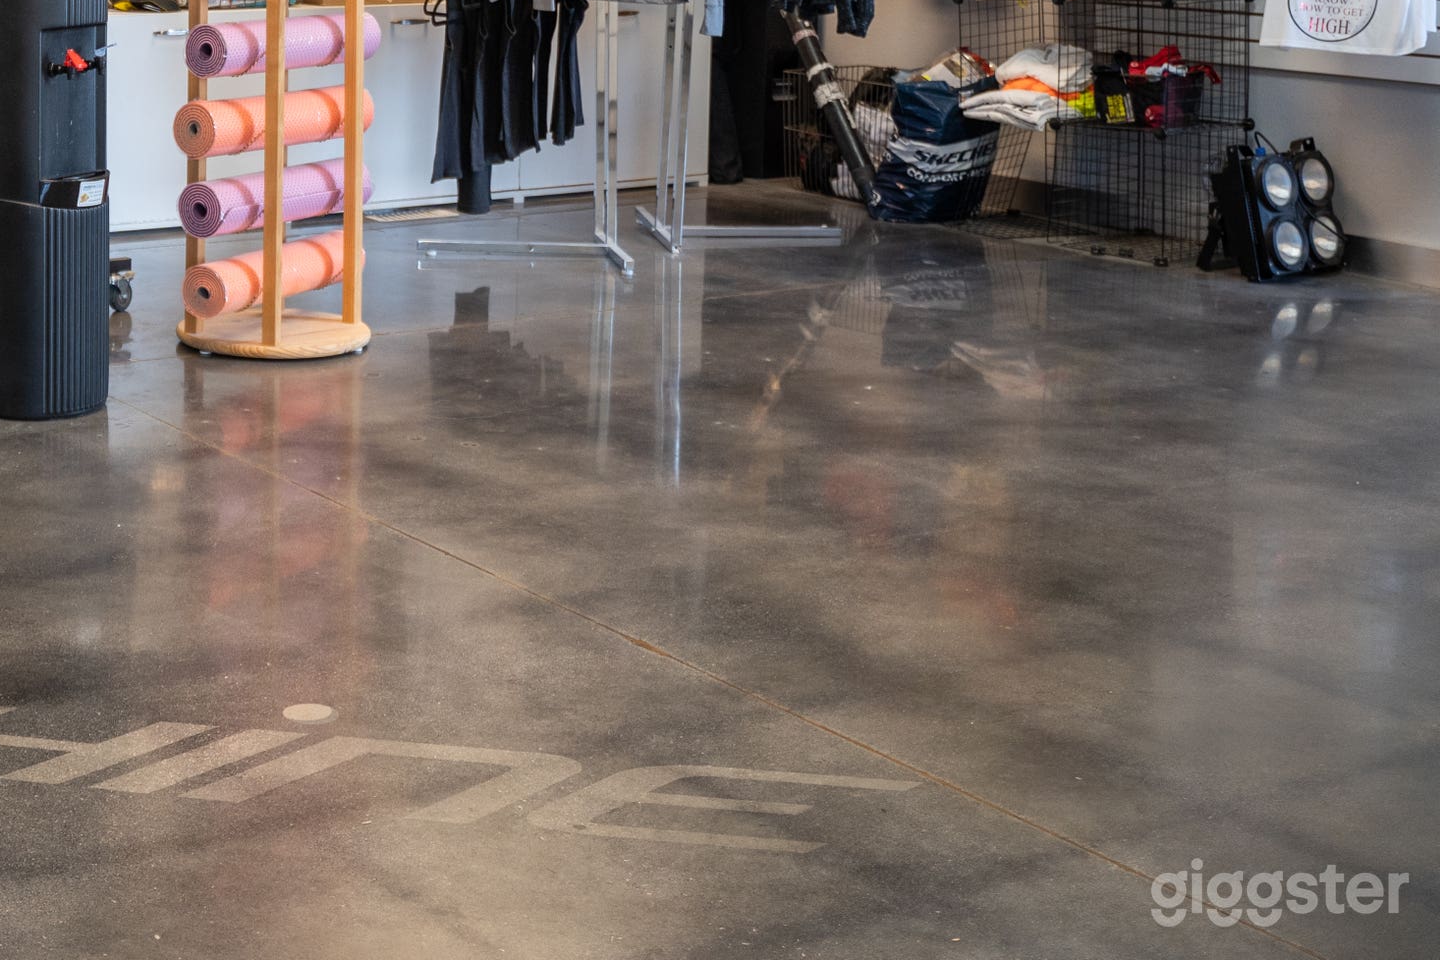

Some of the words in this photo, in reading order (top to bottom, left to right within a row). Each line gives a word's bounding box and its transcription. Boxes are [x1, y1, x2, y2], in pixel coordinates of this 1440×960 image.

[1327, 4, 1341, 14] TO
[1343, 7, 1364, 17] GET
[1309, 17, 1350, 35] HIGH
